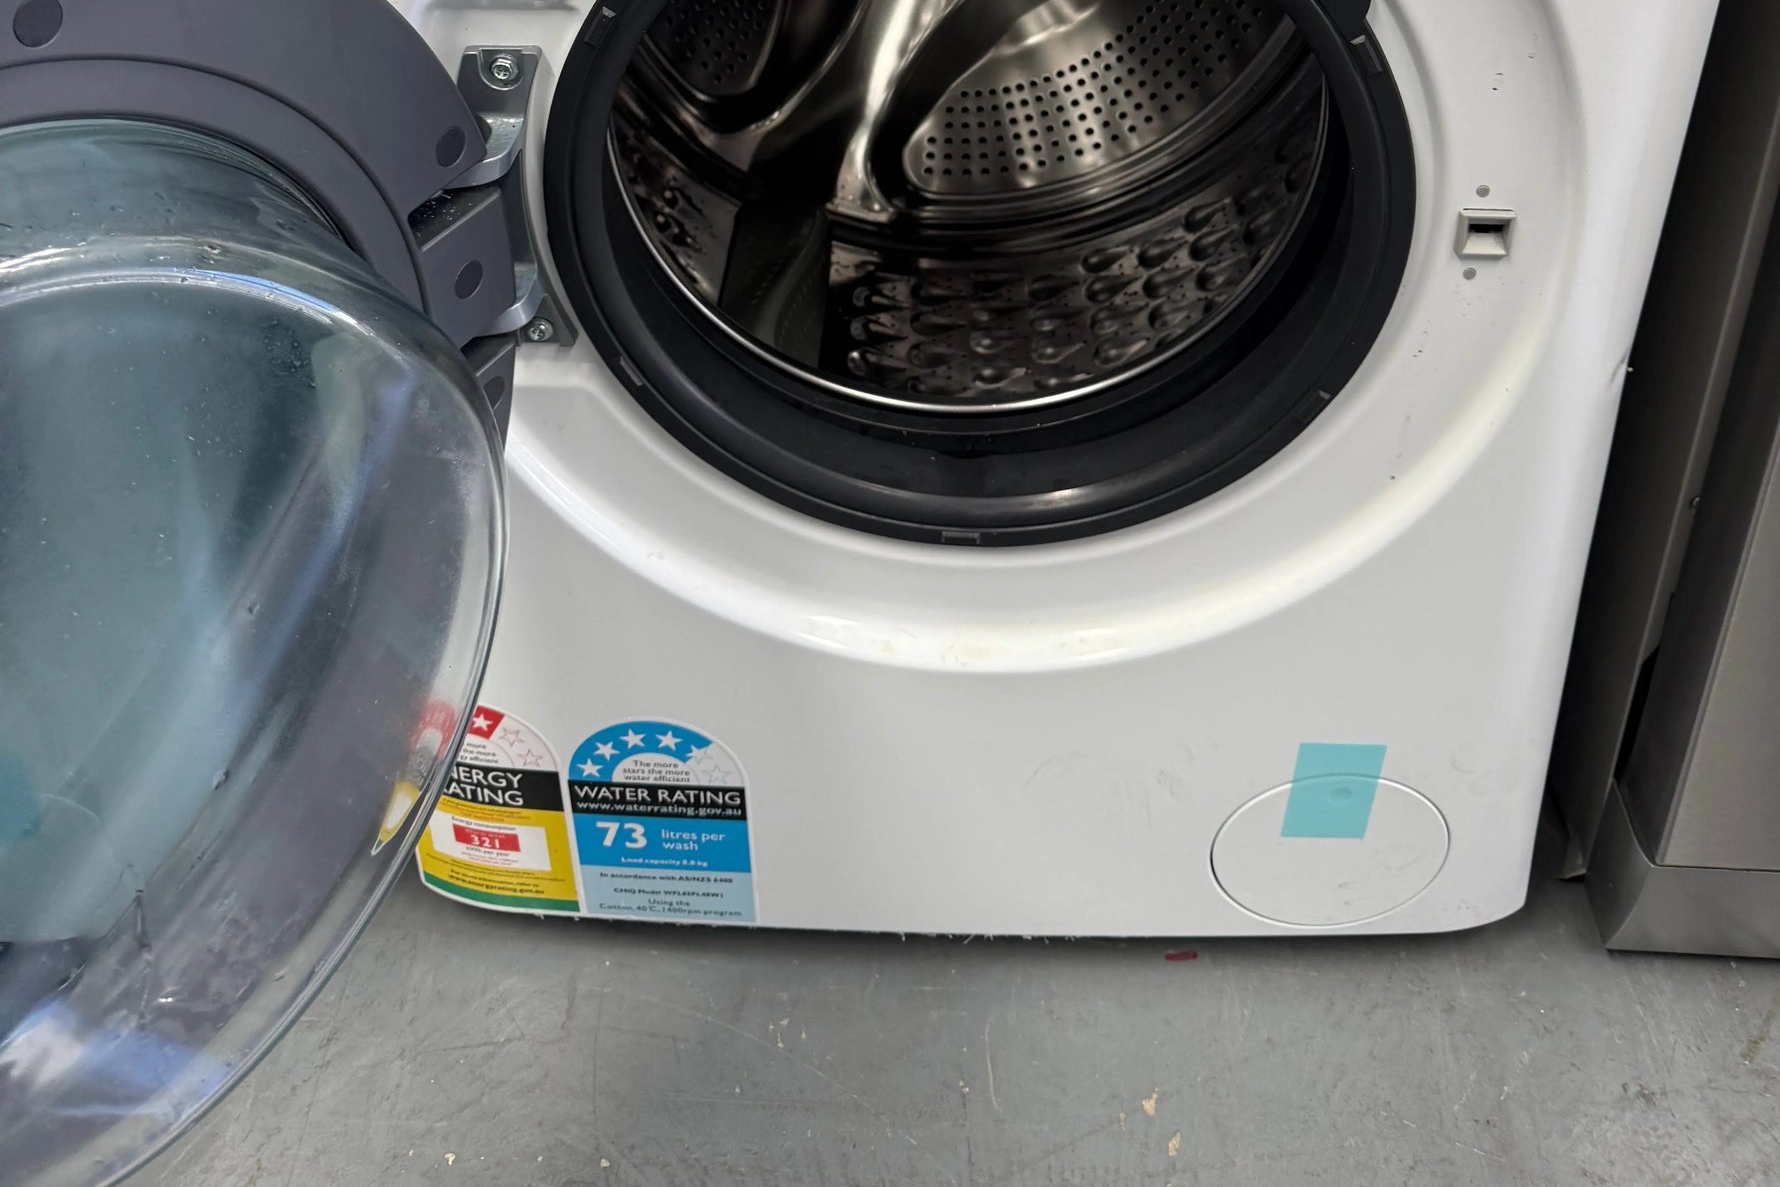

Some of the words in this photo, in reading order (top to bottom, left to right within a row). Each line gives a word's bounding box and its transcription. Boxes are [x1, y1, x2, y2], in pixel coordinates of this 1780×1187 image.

[444, 781, 523, 806] ATING
[574, 785, 651, 802] WATER
[658, 790, 741, 805] RATING
[577, 801, 741, 816] www.waterrating.gov.au
[470, 835, 500, 849] 321
[596, 821, 648, 849] 73
[661, 829, 698, 841] litres
[701, 833, 726, 843] per
[662, 841, 698, 851] wash
[645, 858, 680, 866] capacity
[648, 898, 673, 906] Using
